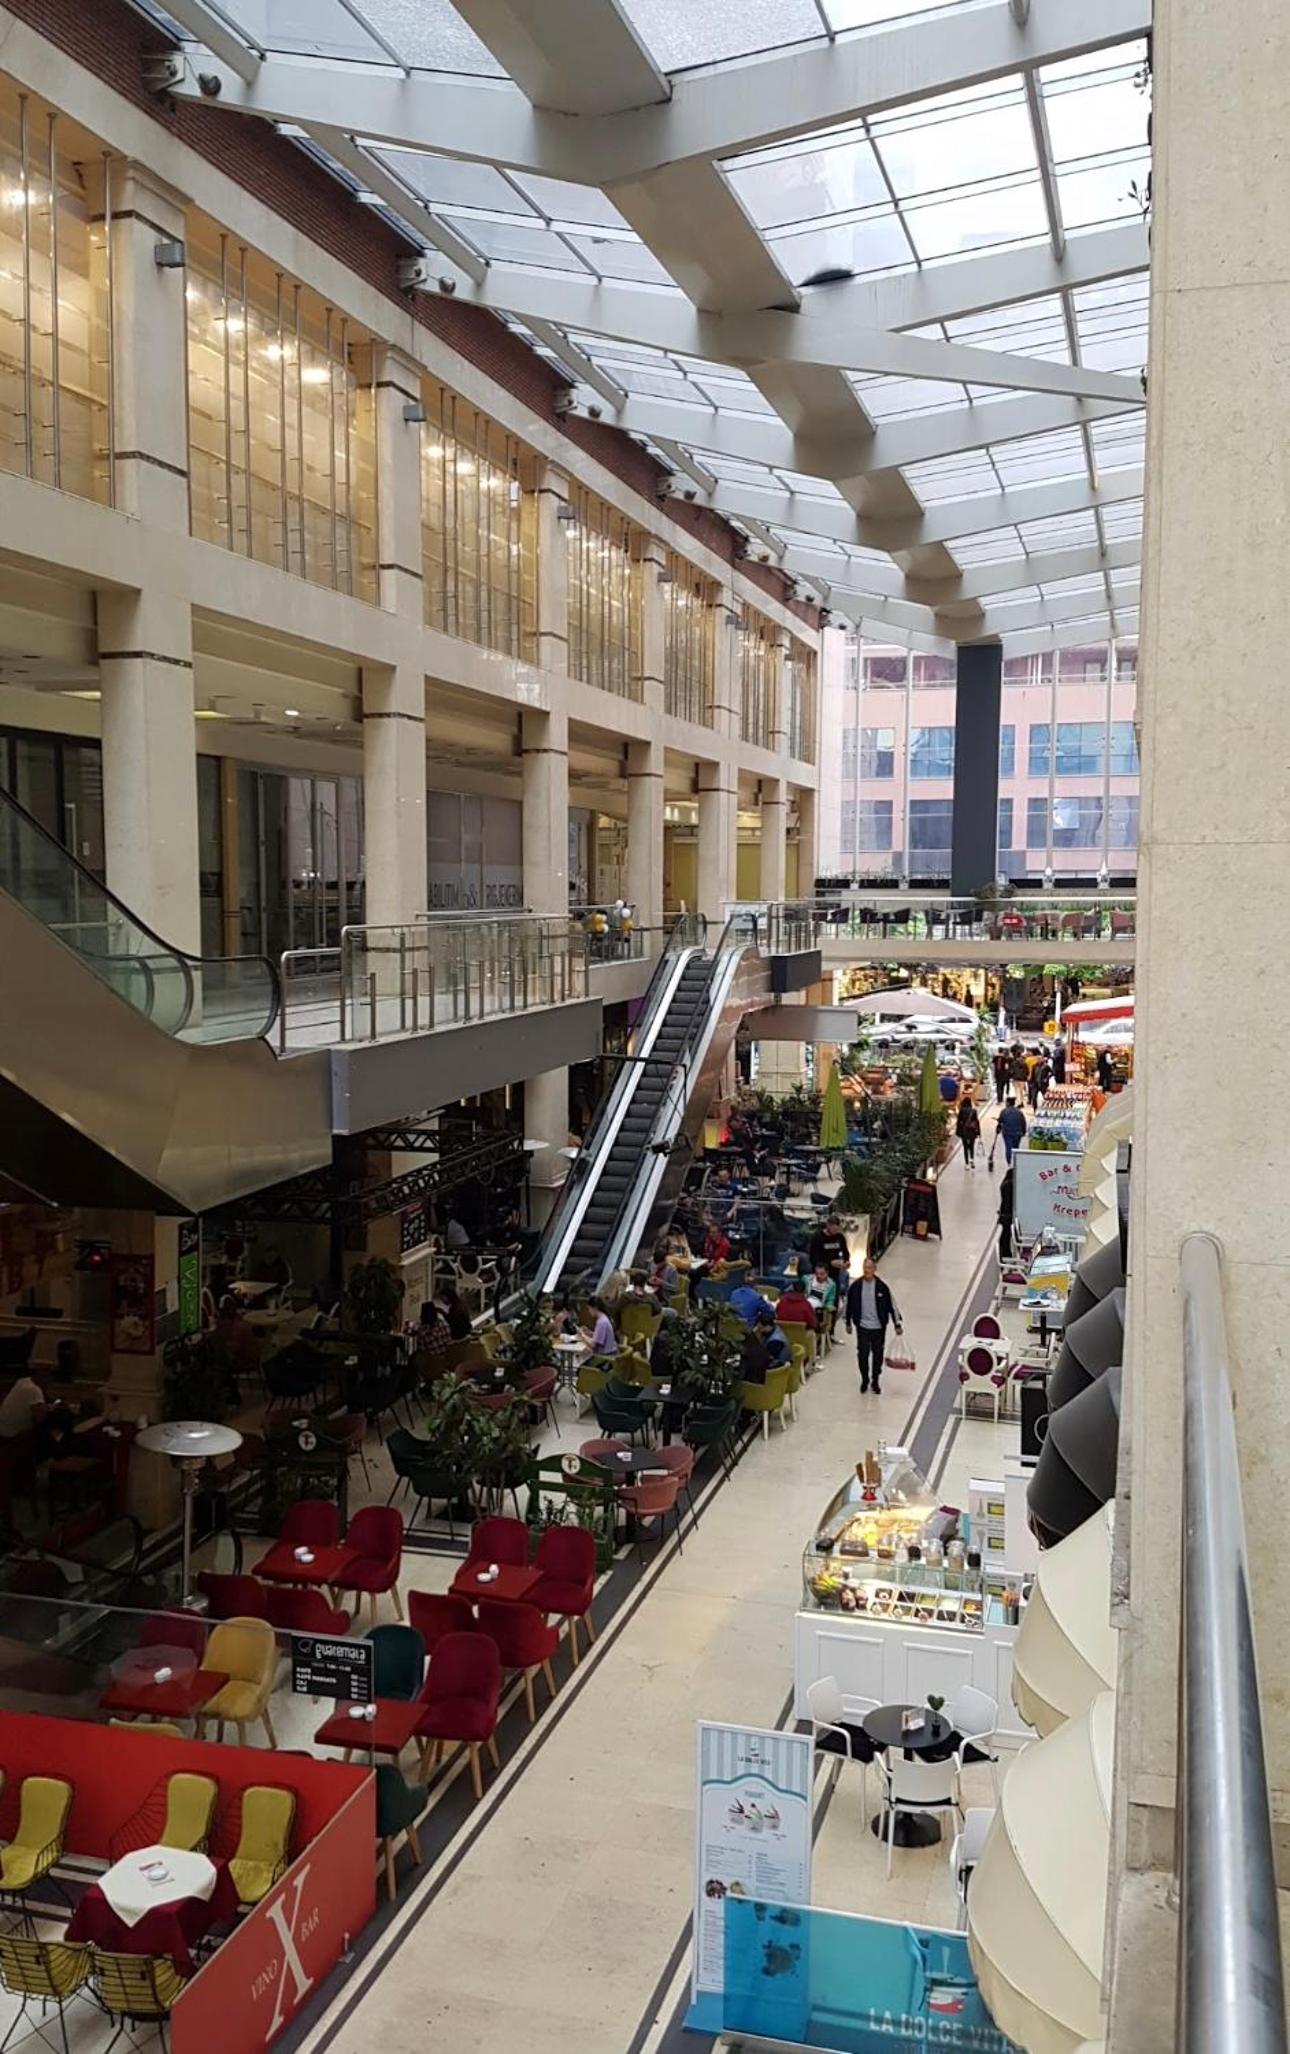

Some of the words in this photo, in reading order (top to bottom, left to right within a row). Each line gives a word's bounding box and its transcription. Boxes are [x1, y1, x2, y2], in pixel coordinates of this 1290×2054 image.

[1039, 1168, 1058, 1180] Bar
[1062, 1163, 1072, 1173] &
[315, 1642, 366, 1660] guatemala
[250, 1958, 279, 2001] VINO
[265, 1862, 314, 2043] X
[300, 1906, 320, 1943] BAR
[869, 2007, 894, 2034] LA
[900, 2013, 963, 2046] DOLCE
